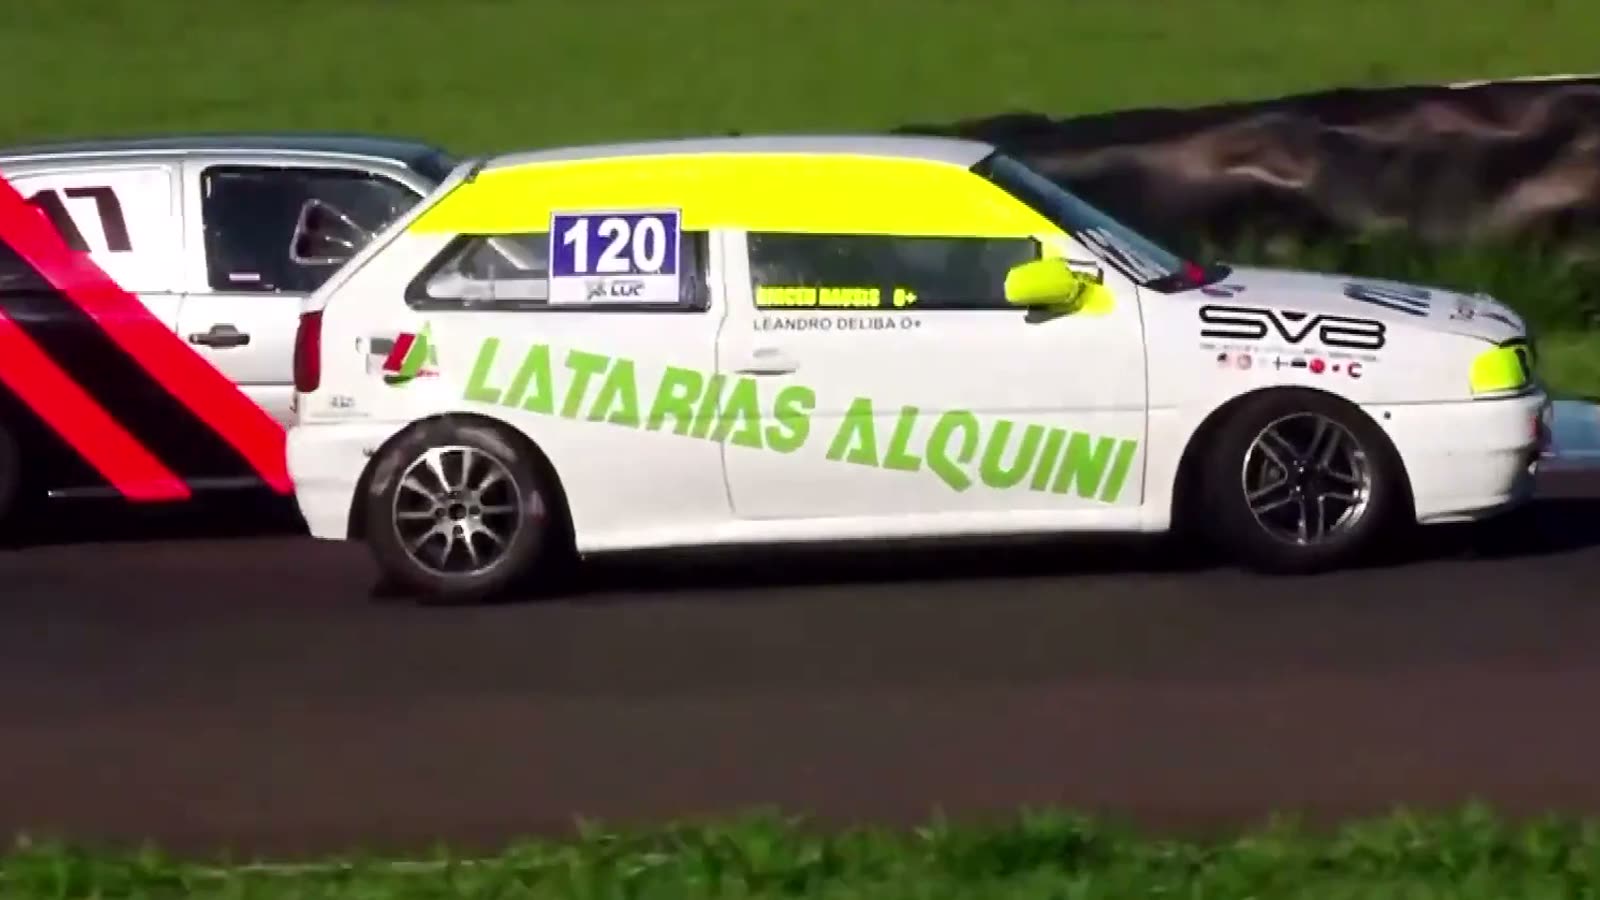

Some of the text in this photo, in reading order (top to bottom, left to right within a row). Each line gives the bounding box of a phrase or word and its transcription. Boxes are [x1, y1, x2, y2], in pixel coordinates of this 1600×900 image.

[563, 217, 666, 273] 120
[753, 317, 832, 331] LEANDRO
[836, 317, 896, 330] DELIBA
[464, 337, 1138, 504] LATARIAS ALQUINI
